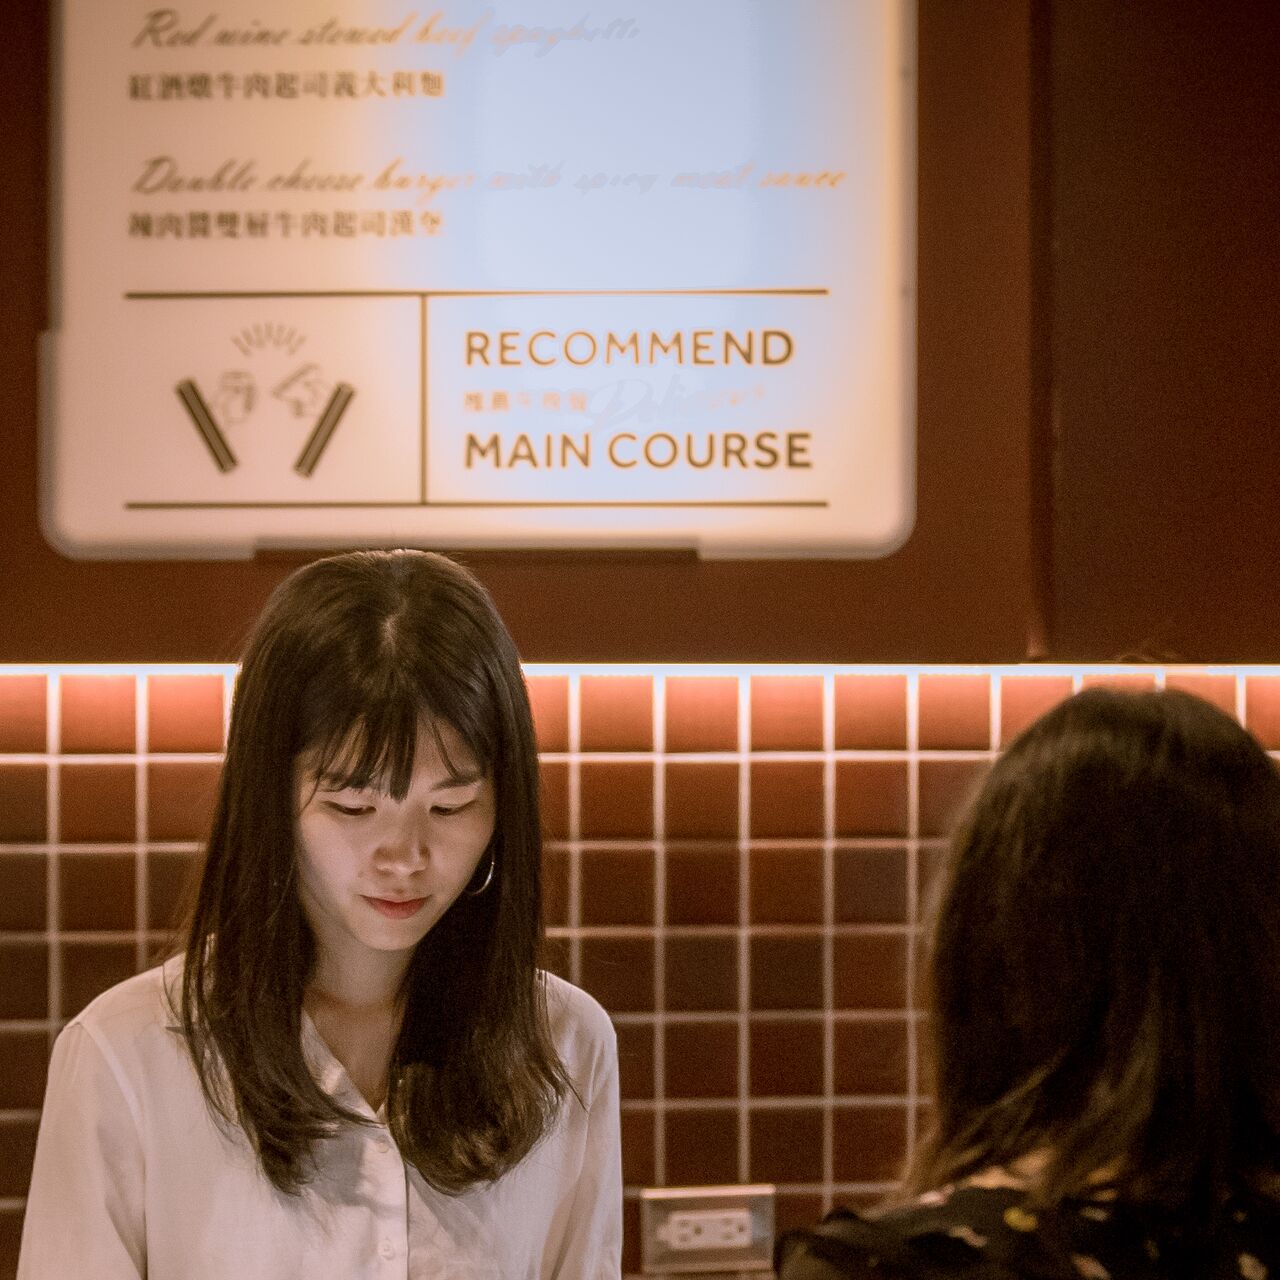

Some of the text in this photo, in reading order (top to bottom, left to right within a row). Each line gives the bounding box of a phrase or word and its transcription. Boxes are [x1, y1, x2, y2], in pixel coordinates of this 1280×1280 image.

[131, 8, 216, 48] Red
[131, 154, 258, 195] Double
[465, 329, 797, 368] RECOMMEND
[465, 432, 814, 470] MAIN COURSE
